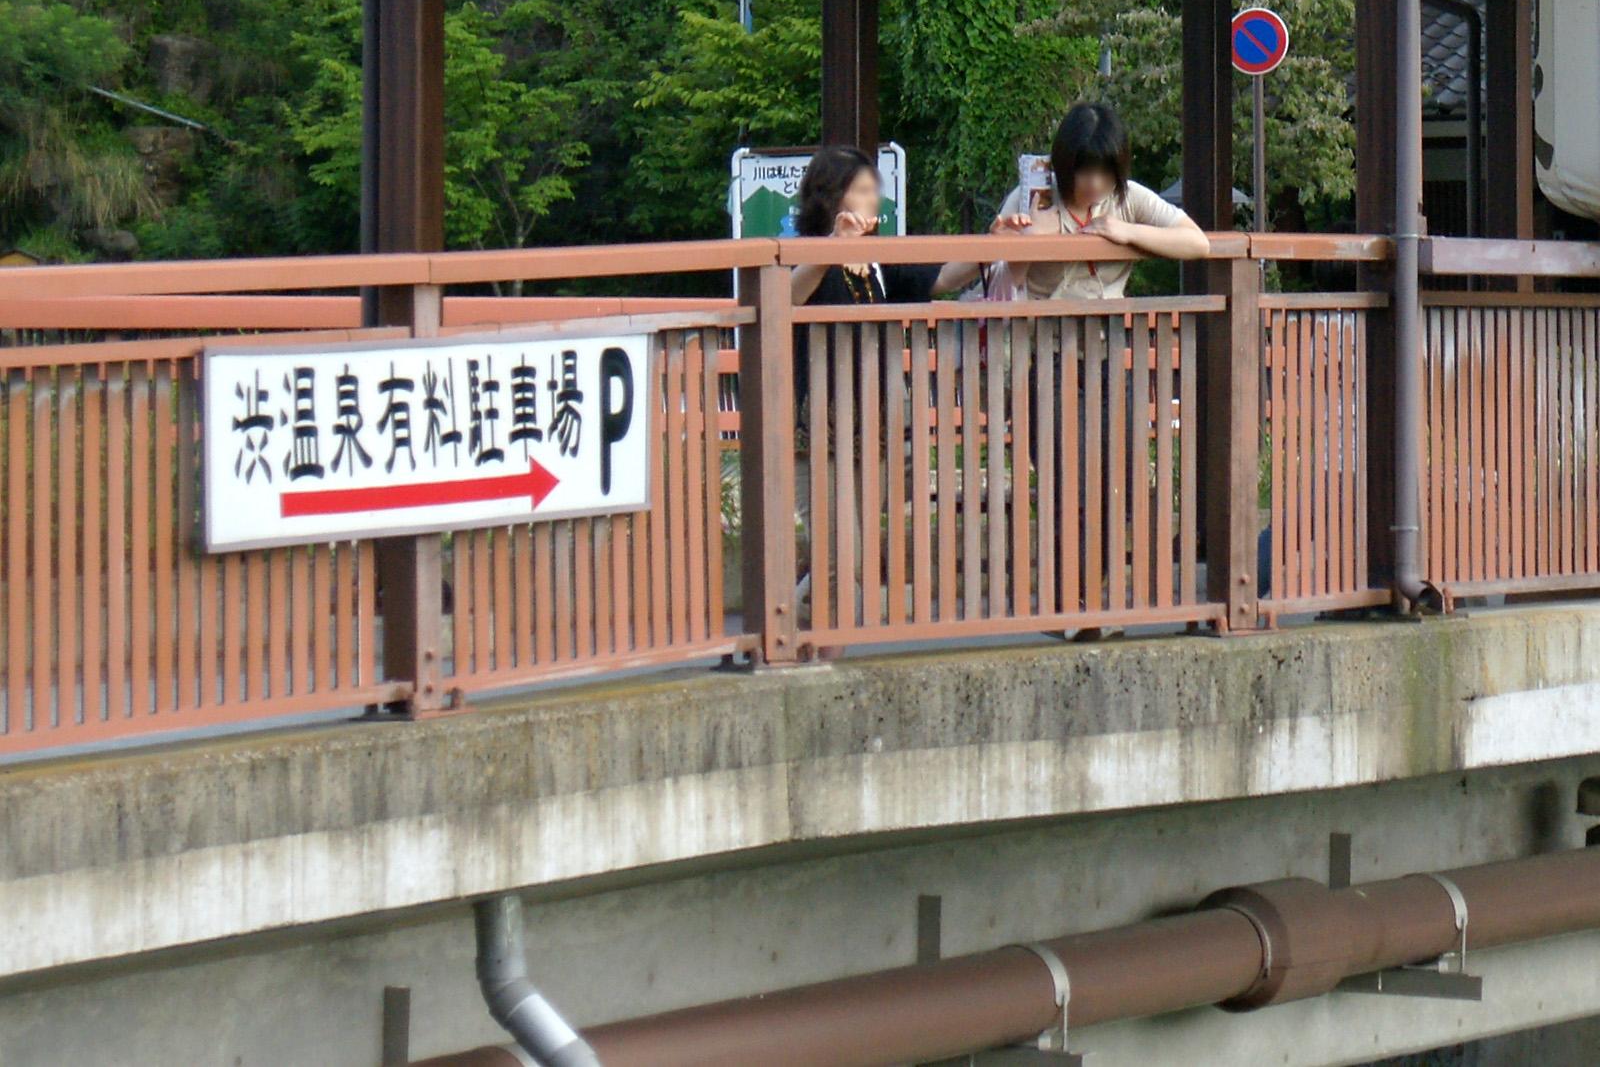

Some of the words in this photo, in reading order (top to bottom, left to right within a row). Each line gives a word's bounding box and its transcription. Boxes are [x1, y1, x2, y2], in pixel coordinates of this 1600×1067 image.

[231, 349, 584, 484] 渋温泉有料駐車場
[599, 346, 635, 496] P
